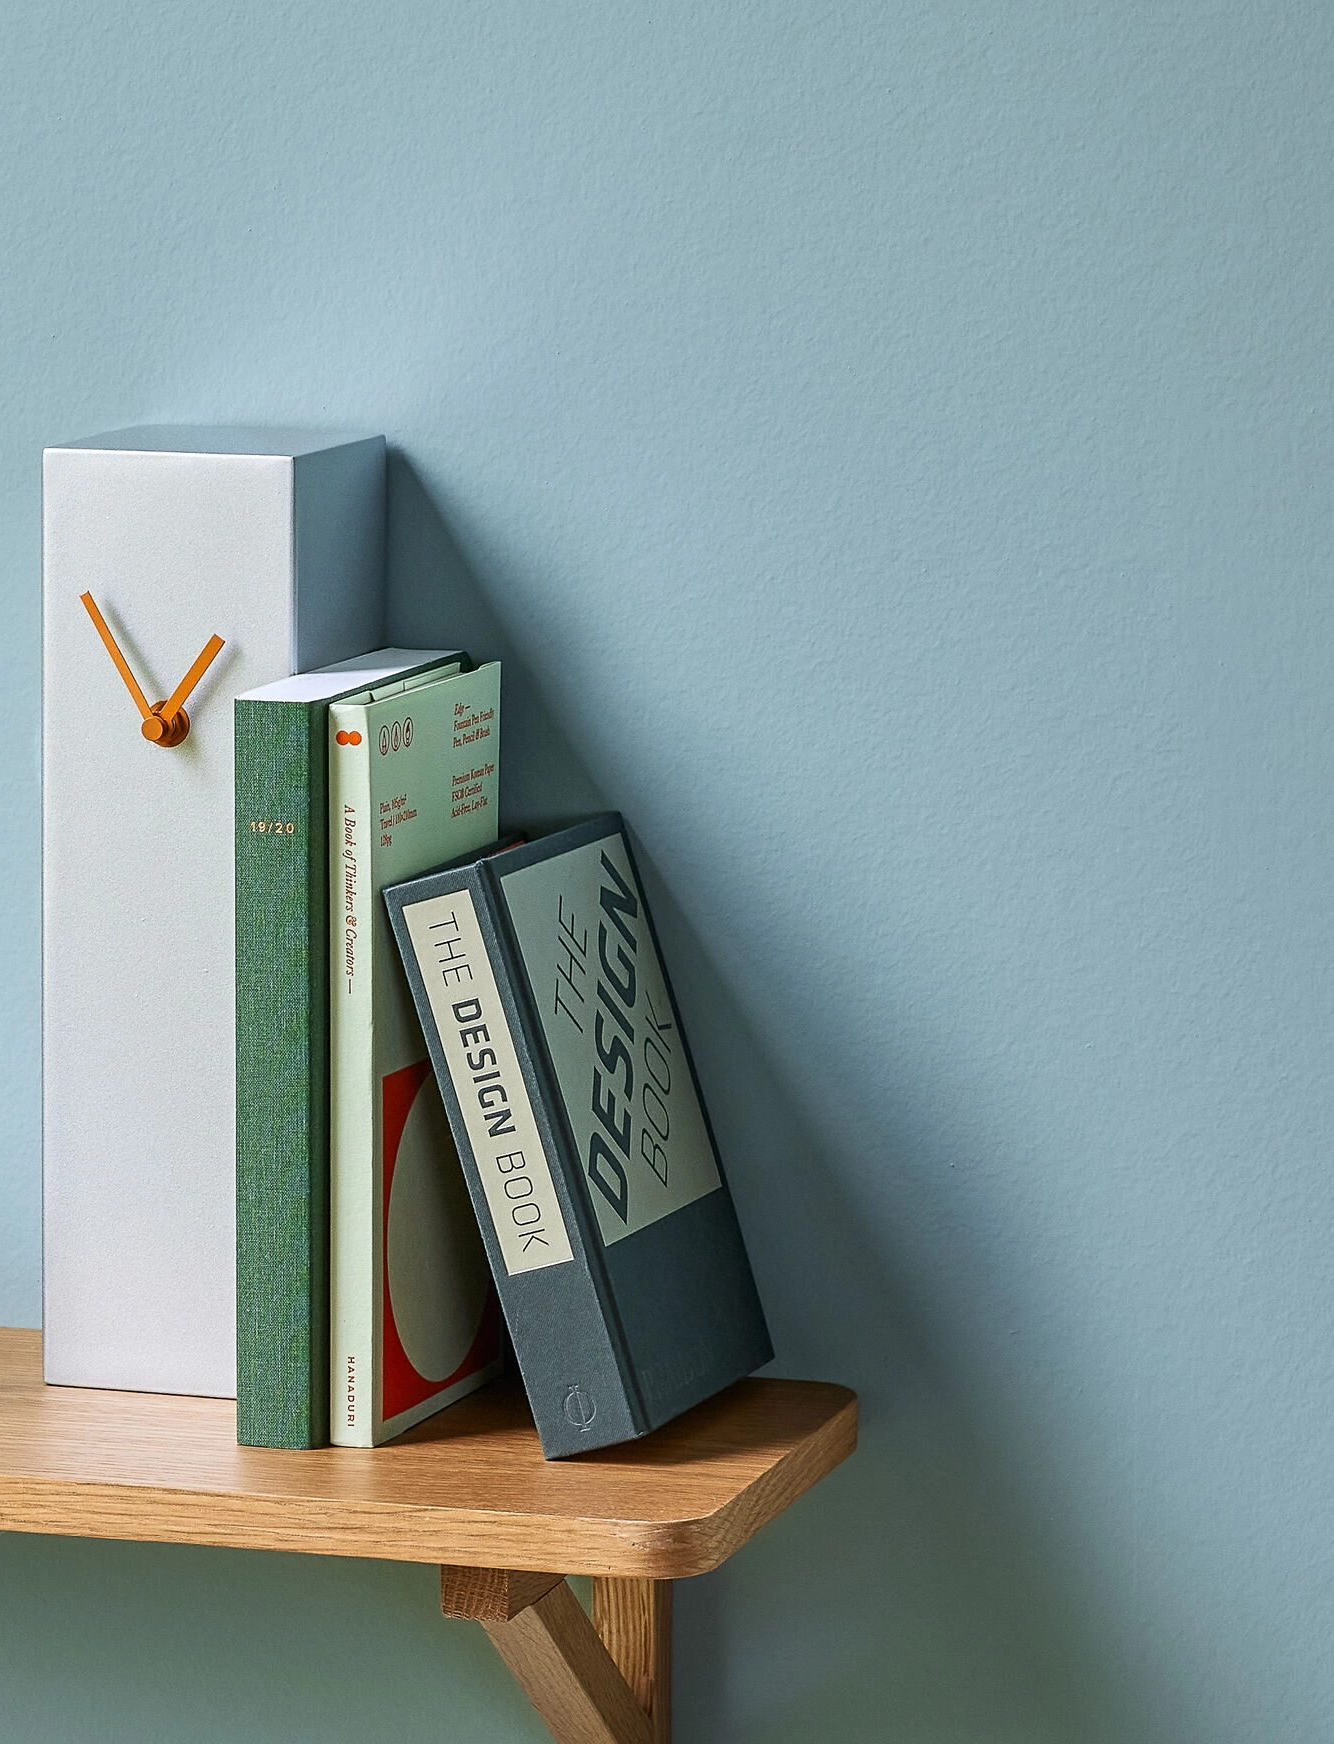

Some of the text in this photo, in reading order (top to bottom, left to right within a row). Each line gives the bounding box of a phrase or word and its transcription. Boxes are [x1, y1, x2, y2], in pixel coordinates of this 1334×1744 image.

[250, 821, 294, 834] 19/20
[345, 804, 356, 814] A
[345, 817, 357, 847] Book
[342, 849, 357, 862] of
[345, 864, 357, 912] Thinkers
[346, 915, 357, 927] &
[346, 929, 358, 977] Creators
[555, 894, 587, 1034] THE
[588, 850, 639, 1225] DESIGN
[428, 911, 549, 1253] THE DESIGN BOOK
[641, 989, 673, 1188] BOOK
[347, 1356, 355, 1427] HANADURI
